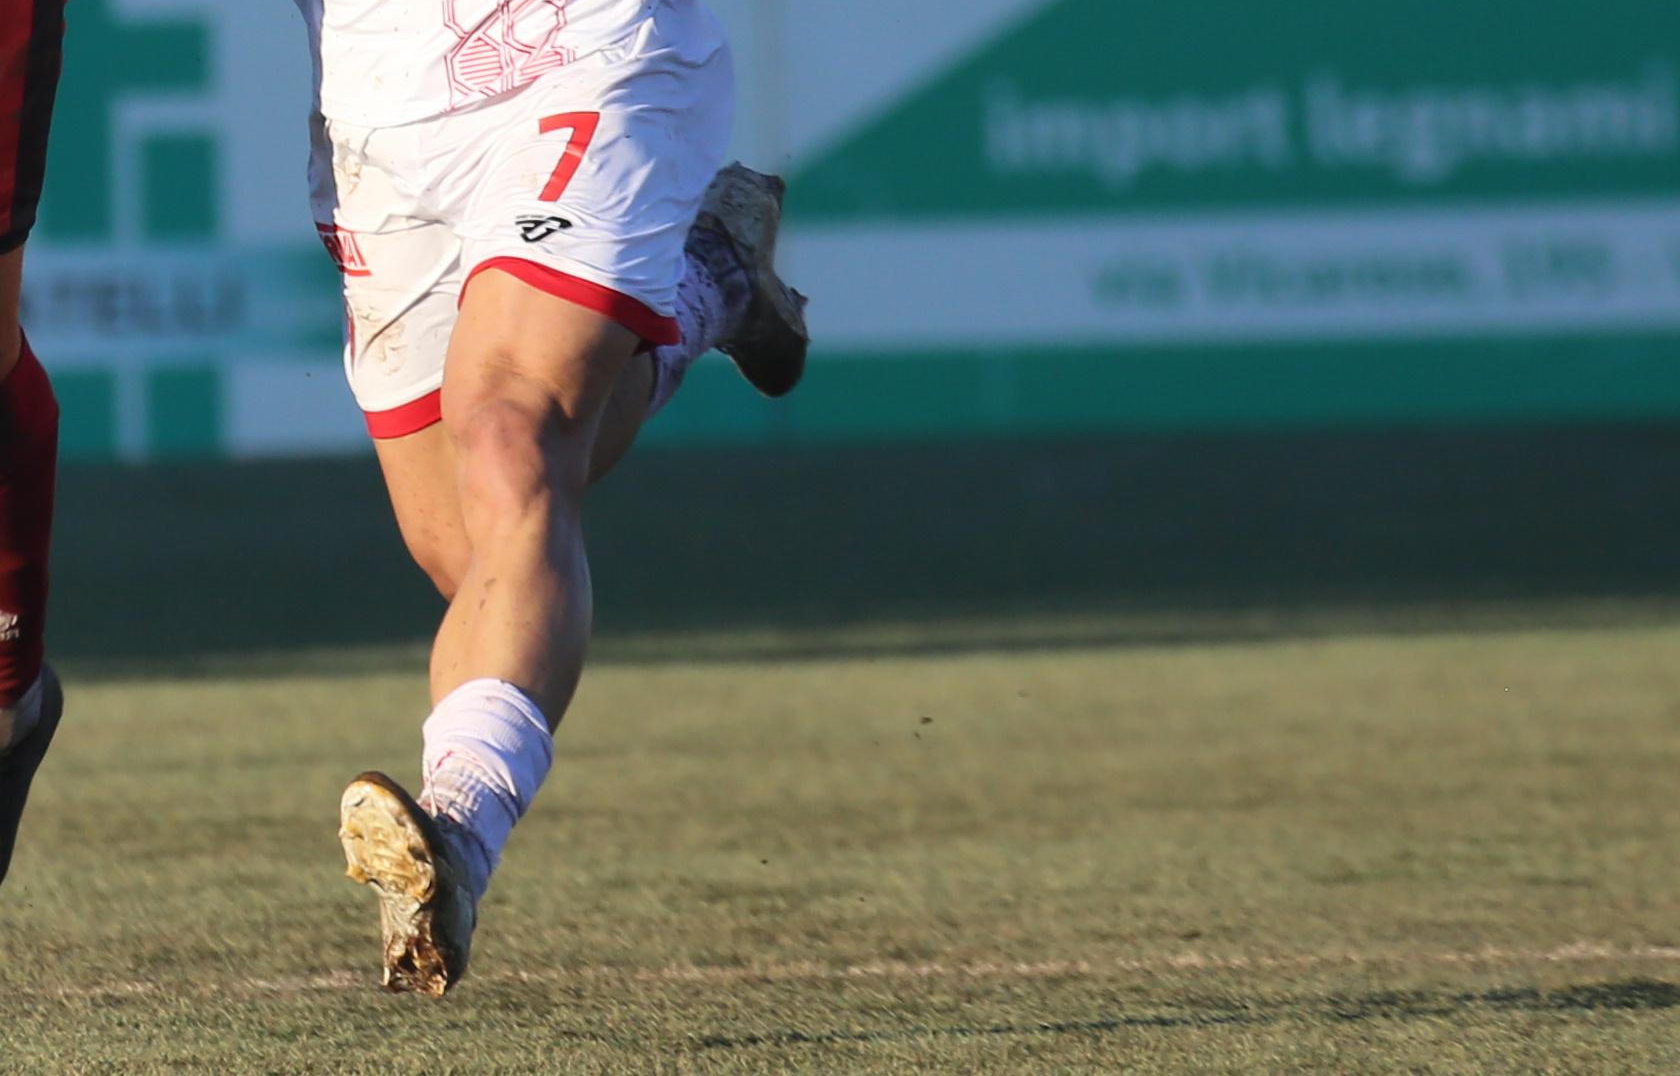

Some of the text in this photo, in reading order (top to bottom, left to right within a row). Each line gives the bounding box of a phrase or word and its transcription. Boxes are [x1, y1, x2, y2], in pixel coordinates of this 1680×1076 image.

[538, 111, 600, 203] 7
[983, 58, 1677, 188] import legnami
